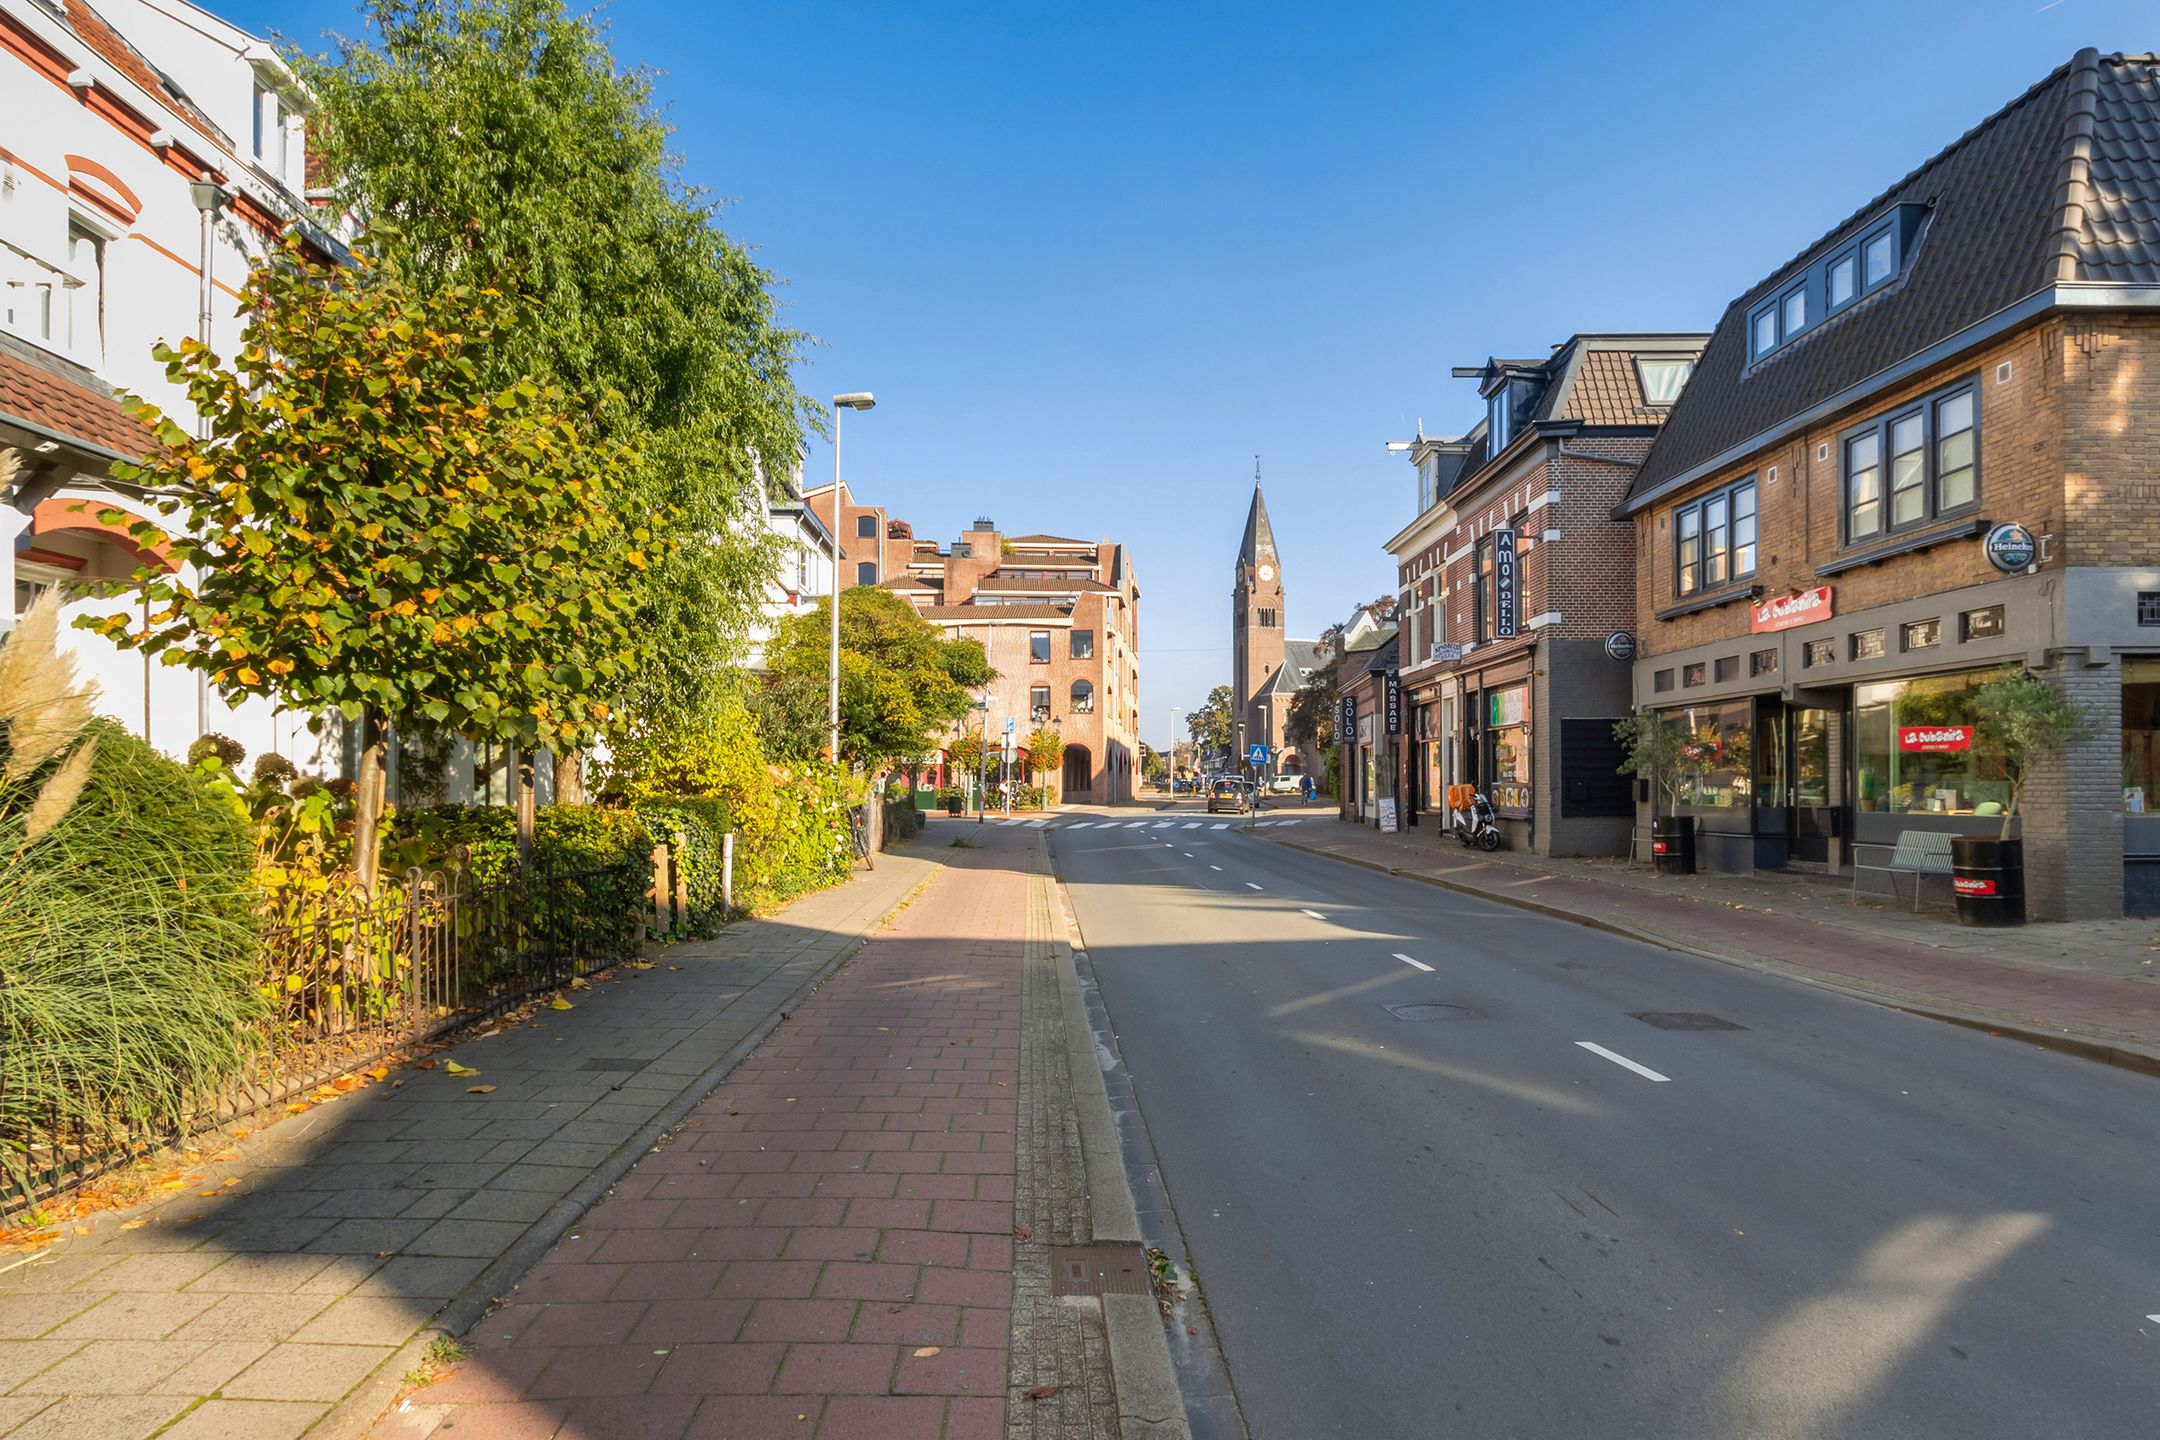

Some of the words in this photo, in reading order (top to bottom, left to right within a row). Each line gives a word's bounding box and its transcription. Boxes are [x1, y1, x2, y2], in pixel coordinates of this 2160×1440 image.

[1993, 542, 2034, 551] Heineke
[1499, 590, 1512, 635] BELLO
[1345, 697, 1354, 736] SOLO
[1388, 680, 1397, 731] MASSAGE
[1919, 728, 1965, 743] Cubanita
